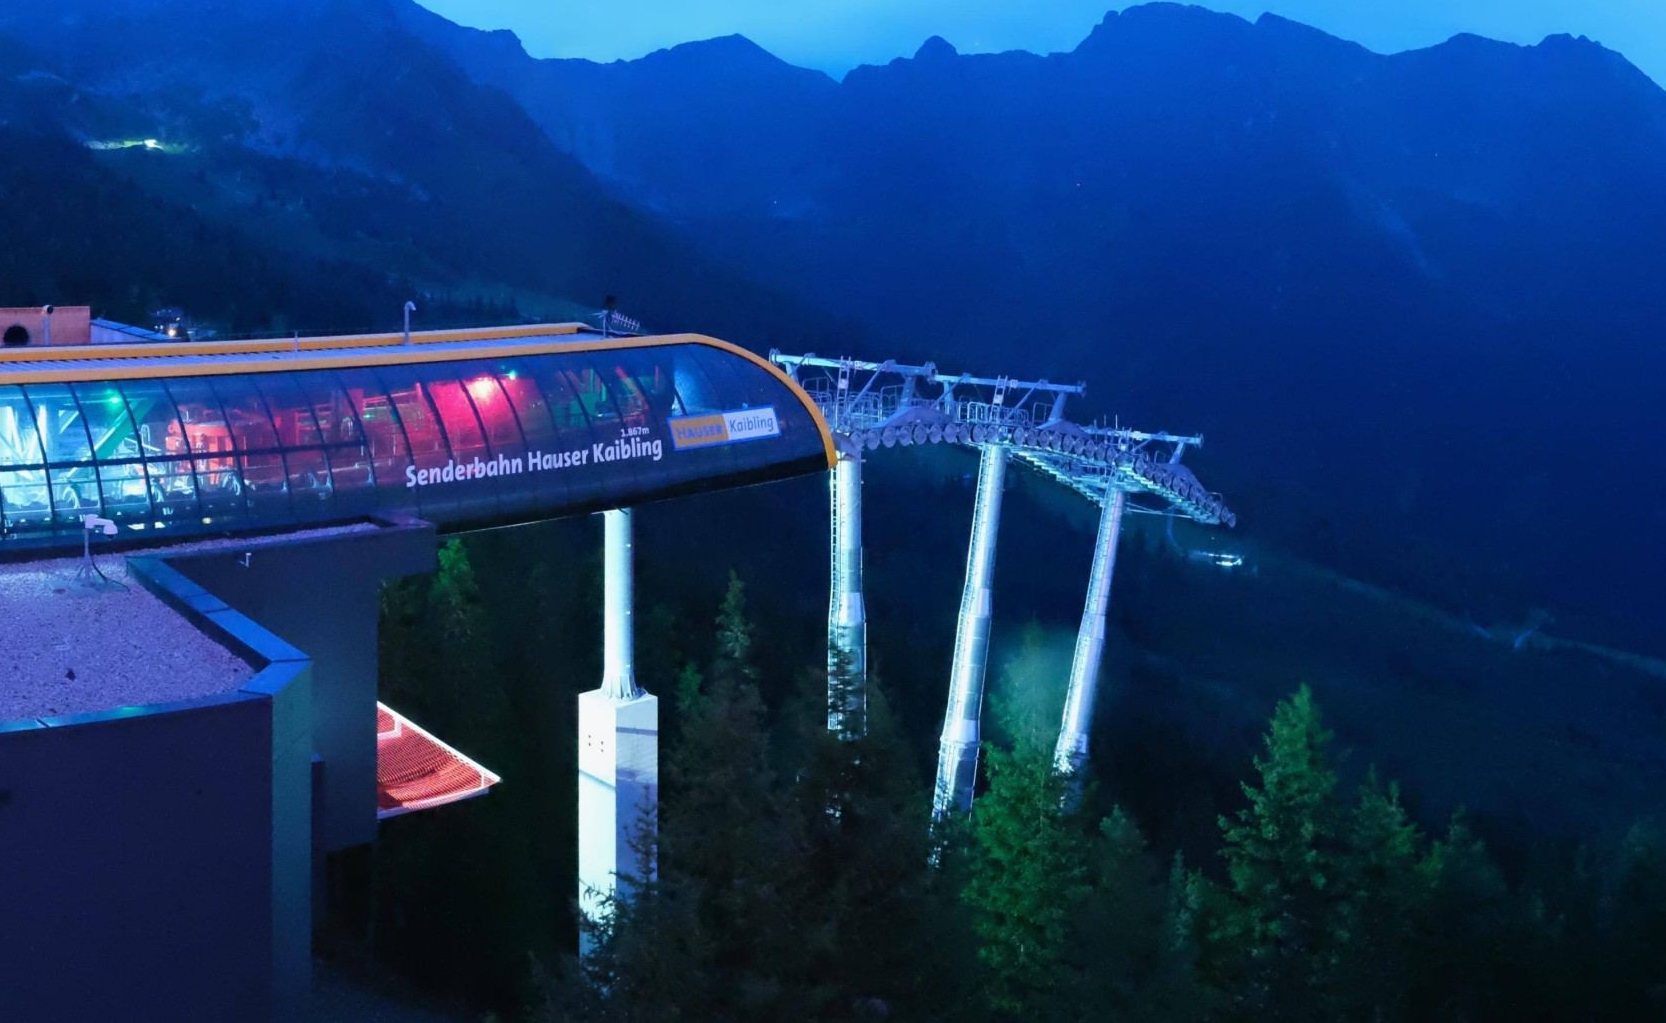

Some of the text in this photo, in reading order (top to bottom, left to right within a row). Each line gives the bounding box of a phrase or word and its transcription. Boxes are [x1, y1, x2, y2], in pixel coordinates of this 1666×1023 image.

[620, 426, 650, 438] 1.867m
[729, 415, 775, 433] Kaibling
[405, 436, 663, 487] Senderbahn Hauser Kaibling
